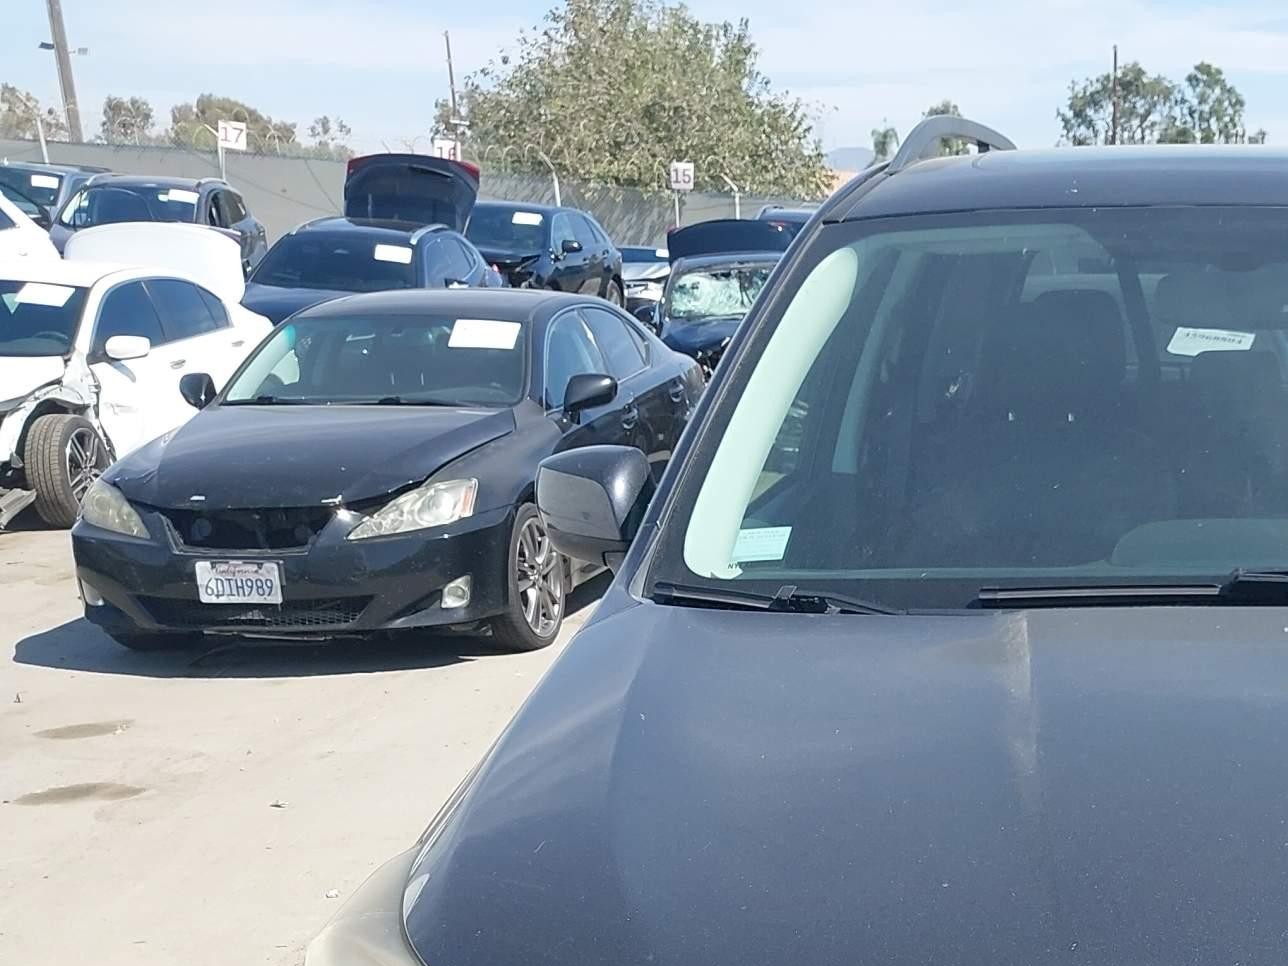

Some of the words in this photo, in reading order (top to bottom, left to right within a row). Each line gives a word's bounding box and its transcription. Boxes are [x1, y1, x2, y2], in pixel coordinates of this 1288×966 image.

[221, 127, 243, 143] 17
[673, 168, 691, 184] 15
[205, 577, 274, 598] 6DIH989
